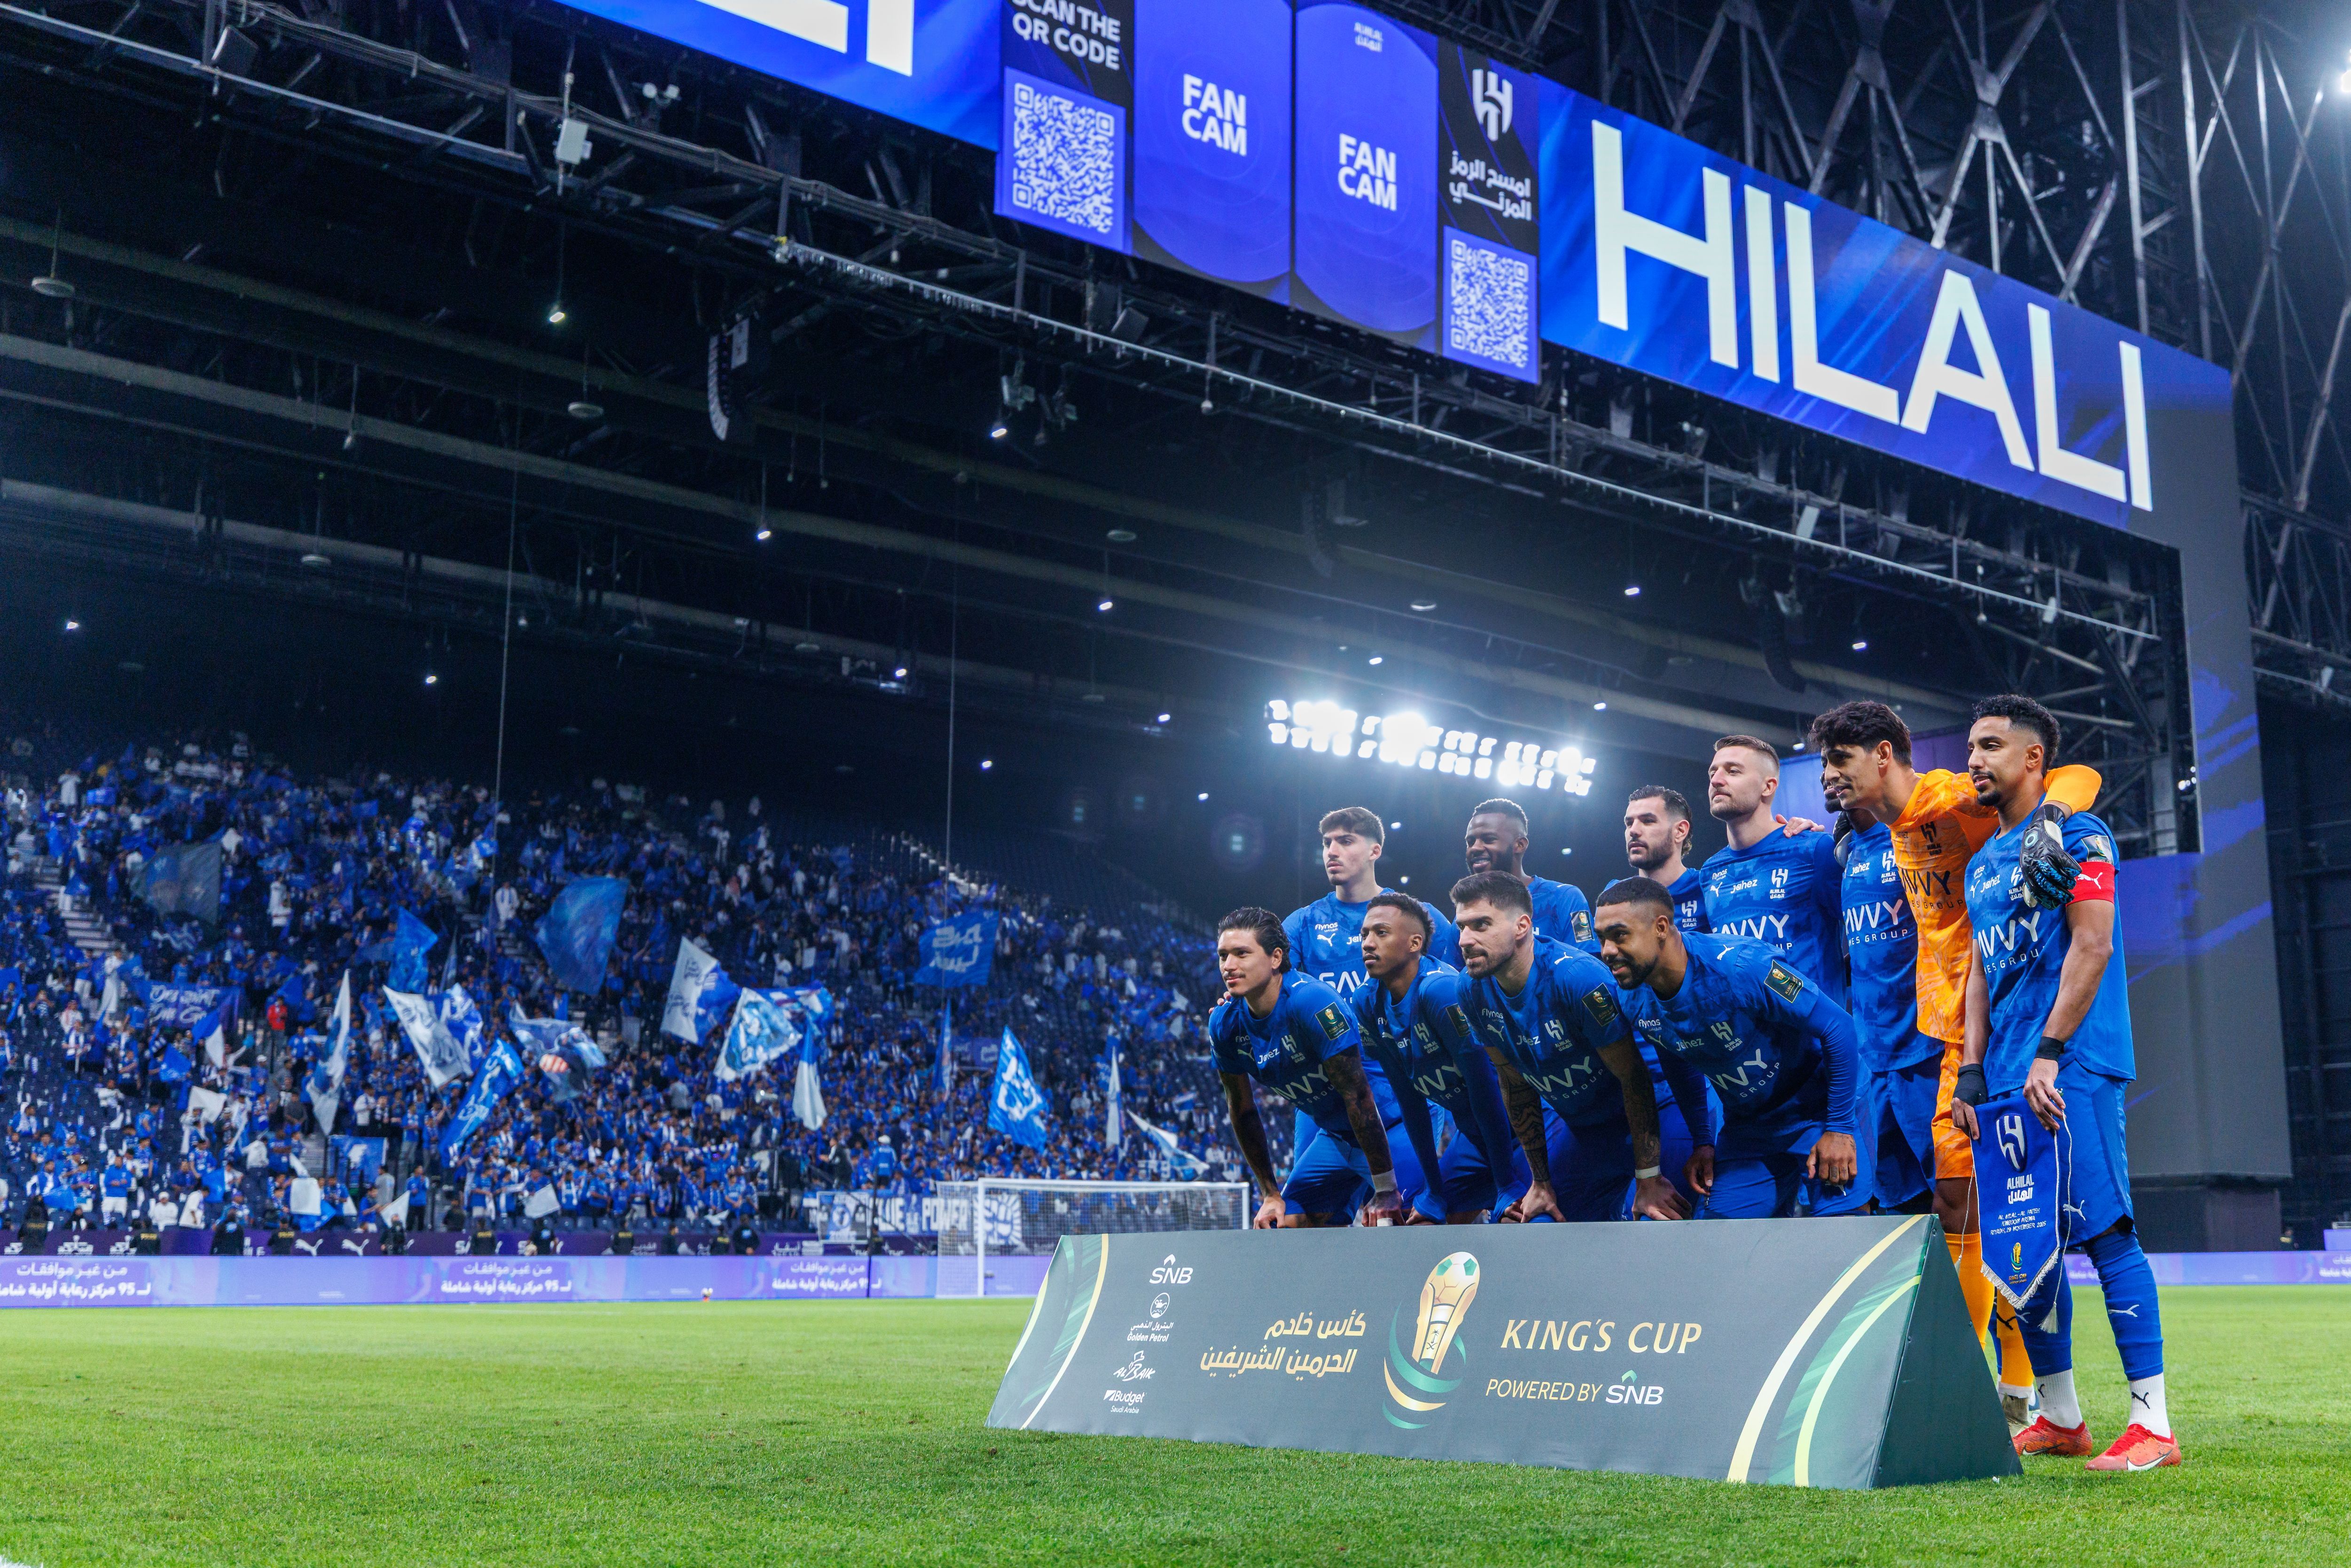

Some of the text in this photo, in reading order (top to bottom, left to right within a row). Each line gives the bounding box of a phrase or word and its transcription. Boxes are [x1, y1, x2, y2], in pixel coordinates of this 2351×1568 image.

[1077, 6, 1120, 42] THE
[1012, 12, 1119, 70] QR CODE
[1183, 73, 1246, 126] FAN
[1182, 108, 1247, 157] CAM
[1339, 133, 1396, 183] FAN
[1449, 150, 1531, 198] امسح الرمز
[1337, 166, 1397, 211] CAM
[1592, 118, 2153, 512] HILALI
[1901, 869, 1951, 897] AVVY
[2008, 886, 2023, 895] ALHILA
[1923, 899, 1963, 909] GROUP
[1315, 922, 1338, 931] flynas
[1712, 914, 1789, 940] VVY
[1843, 899, 1903, 936] AVVY
[1865, 929, 1908, 943] GROUP
[1977, 911, 2041, 959] AVVY
[2000, 946, 2045, 969] GROU
[1319, 970, 1369, 993] SAV
[1482, 1008, 1504, 1019] flynas
[1639, 1019, 1661, 1029] flynas
[1724, 1038, 1741, 1048] ALHILAL
[1562, 1069, 1603, 1099] GROUP
[1740, 1062, 1780, 1098] GROUP
[1306, 1084, 1335, 1104] GROU
[2007, 1173, 2035, 1190] ALHILAL
[2008, 1187, 2033, 1205] الهلال
[922, 1198, 969, 1232] POWER
[2001, 1218, 2021, 1227] KINGDOM
[2013, 1222, 2035, 1232] NOVEMBER
[1149, 1267, 1194, 1284] SNB
[88, 1283, 116, 1299] مركز
[118, 1282, 136, 1295] 95
[1151, 1321, 1174, 1331] البترول
[1264, 1309, 1366, 1340] كأس خادم
[1127, 1333, 1170, 1342] Golden Petrol
[1500, 1319, 1703, 1354] KING'S CUP
[1200, 1344, 1358, 1381] الحرمين الشريفين
[1114, 1390, 1145, 1406] Budget
[1485, 1379, 1664, 1405] POWERED BY SNB
